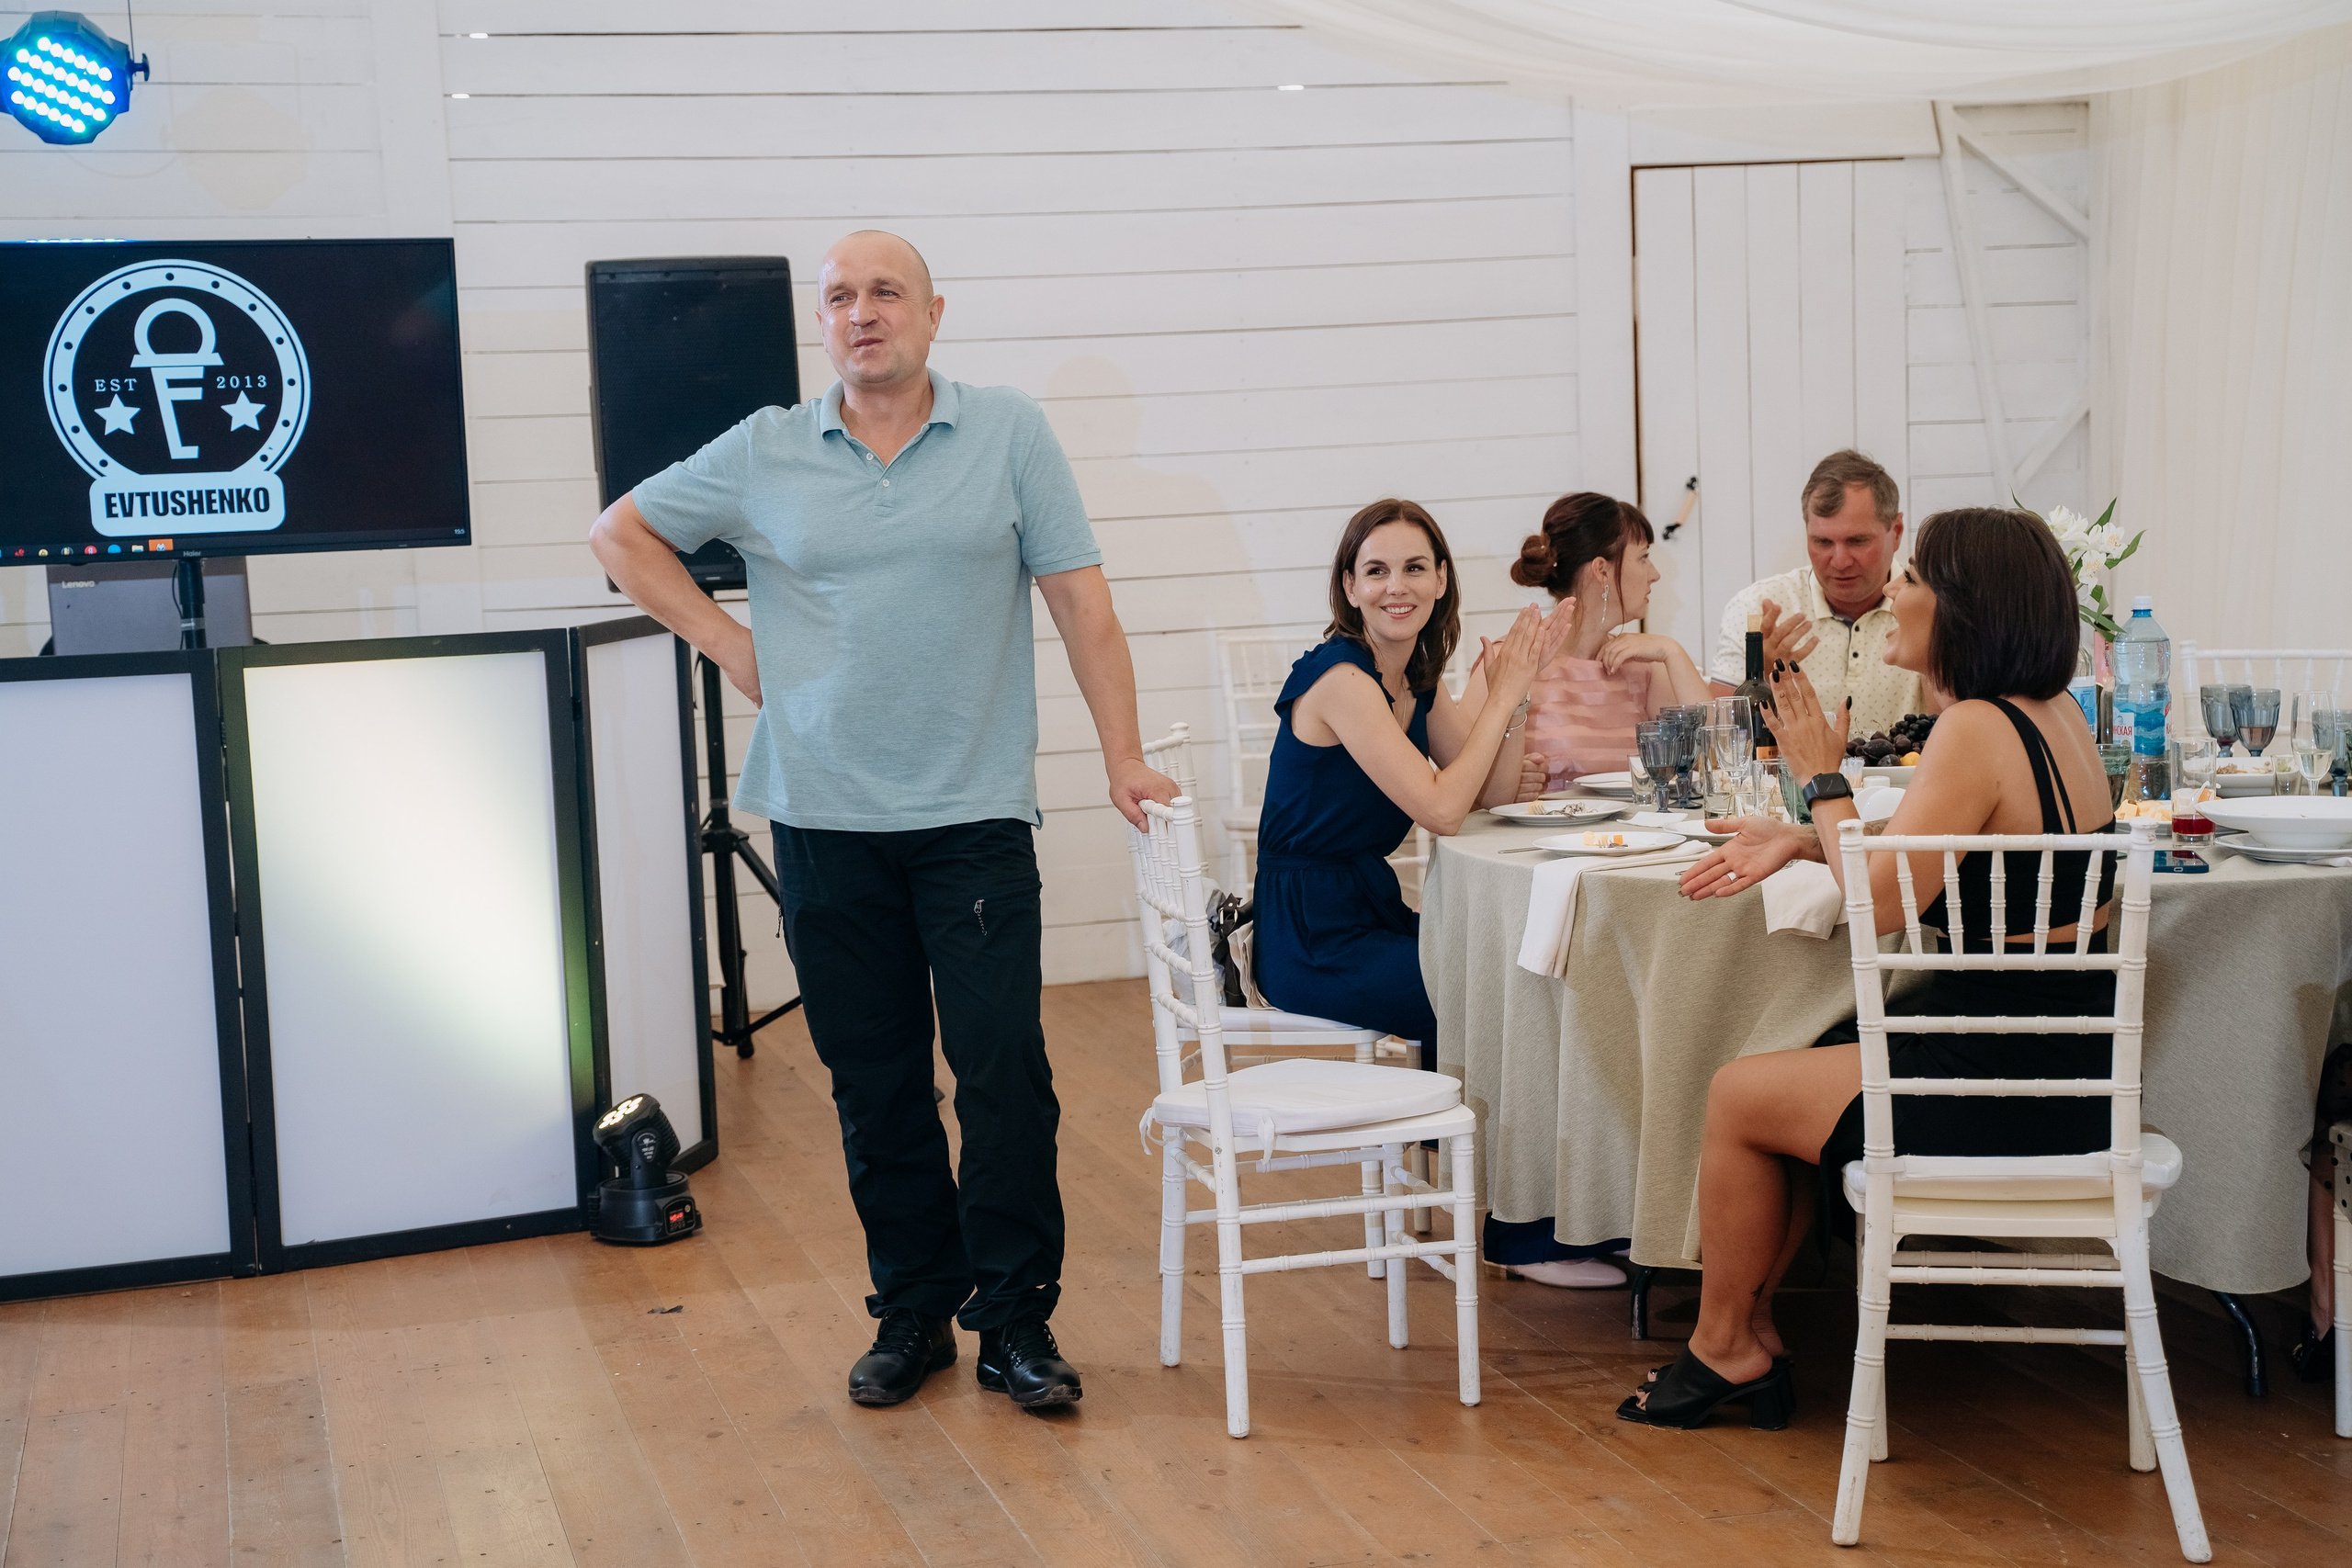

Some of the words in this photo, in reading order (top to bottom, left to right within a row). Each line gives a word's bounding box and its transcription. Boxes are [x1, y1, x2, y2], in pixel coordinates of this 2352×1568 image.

[94, 378, 138, 392] EST
[216, 375, 267, 389] 2013
[104, 487, 271, 518] EVTUSHENKO
[62, 581, 96, 589] Lenovo
